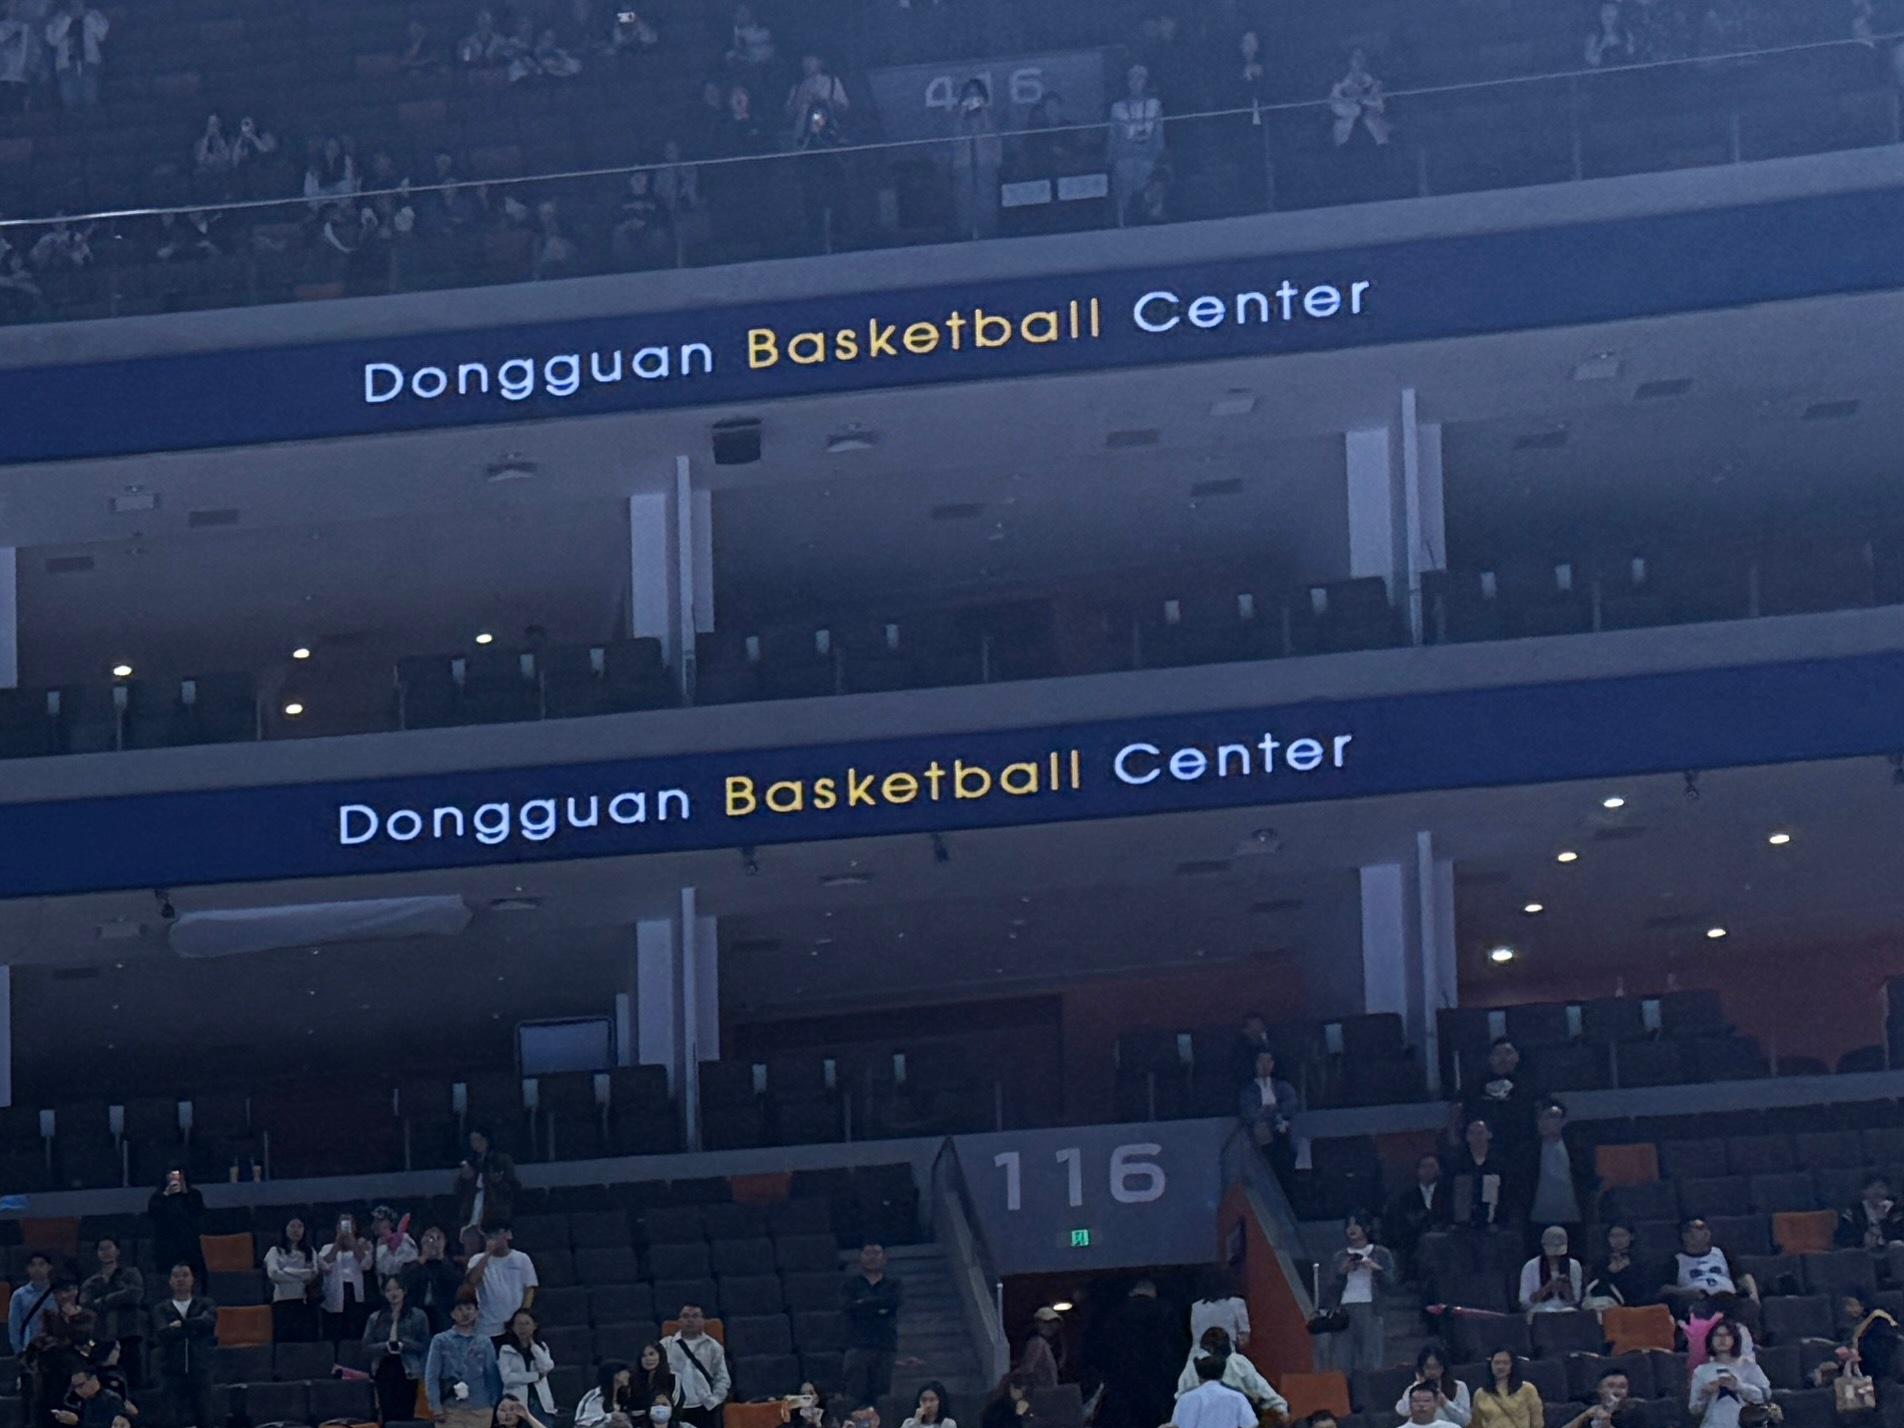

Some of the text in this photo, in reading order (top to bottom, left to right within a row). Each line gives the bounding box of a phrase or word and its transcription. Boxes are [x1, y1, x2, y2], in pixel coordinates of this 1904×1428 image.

[364, 278, 1371, 403] Dongguan Basketball Center
[338, 731, 1353, 846] Dongguan Basketball Center
[995, 1142, 1166, 1210] 116
